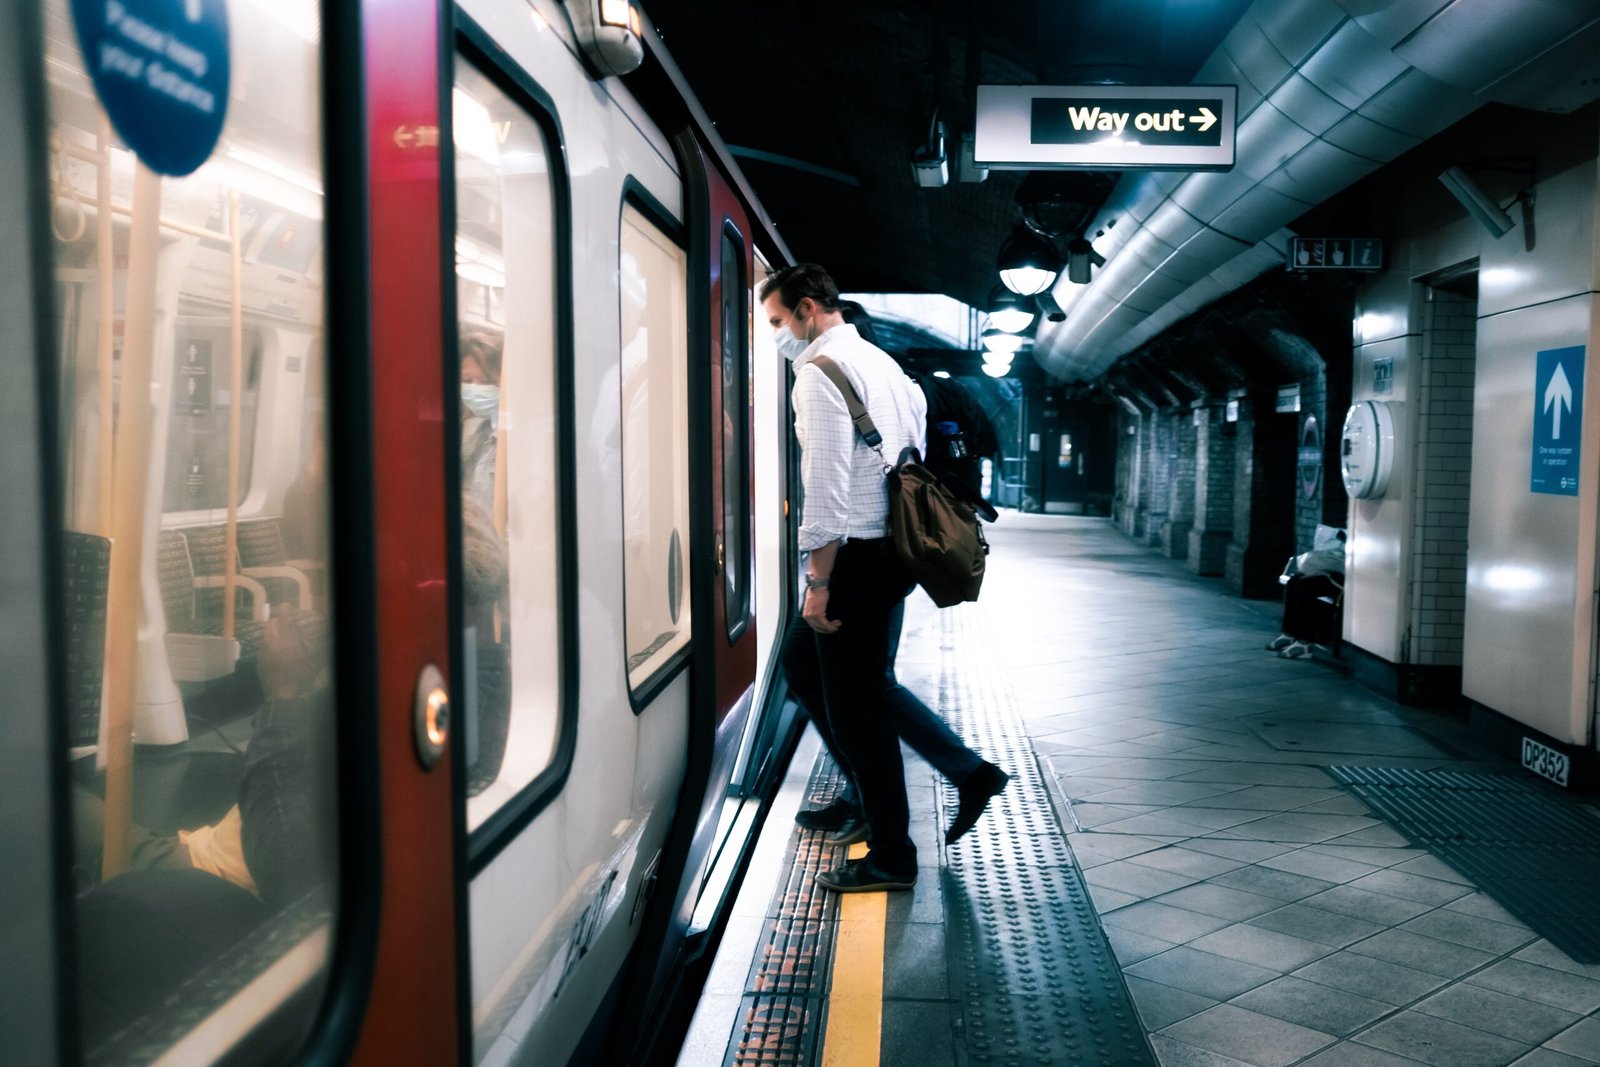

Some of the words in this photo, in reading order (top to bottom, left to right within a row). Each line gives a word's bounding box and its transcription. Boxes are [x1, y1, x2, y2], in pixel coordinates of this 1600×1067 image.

[1068, 106, 1130, 136] Way
[1134, 109, 1185, 132] out
[1525, 740, 1565, 784] DP352
[753, 943, 822, 992] THE
[732, 1003, 809, 1067] IND
